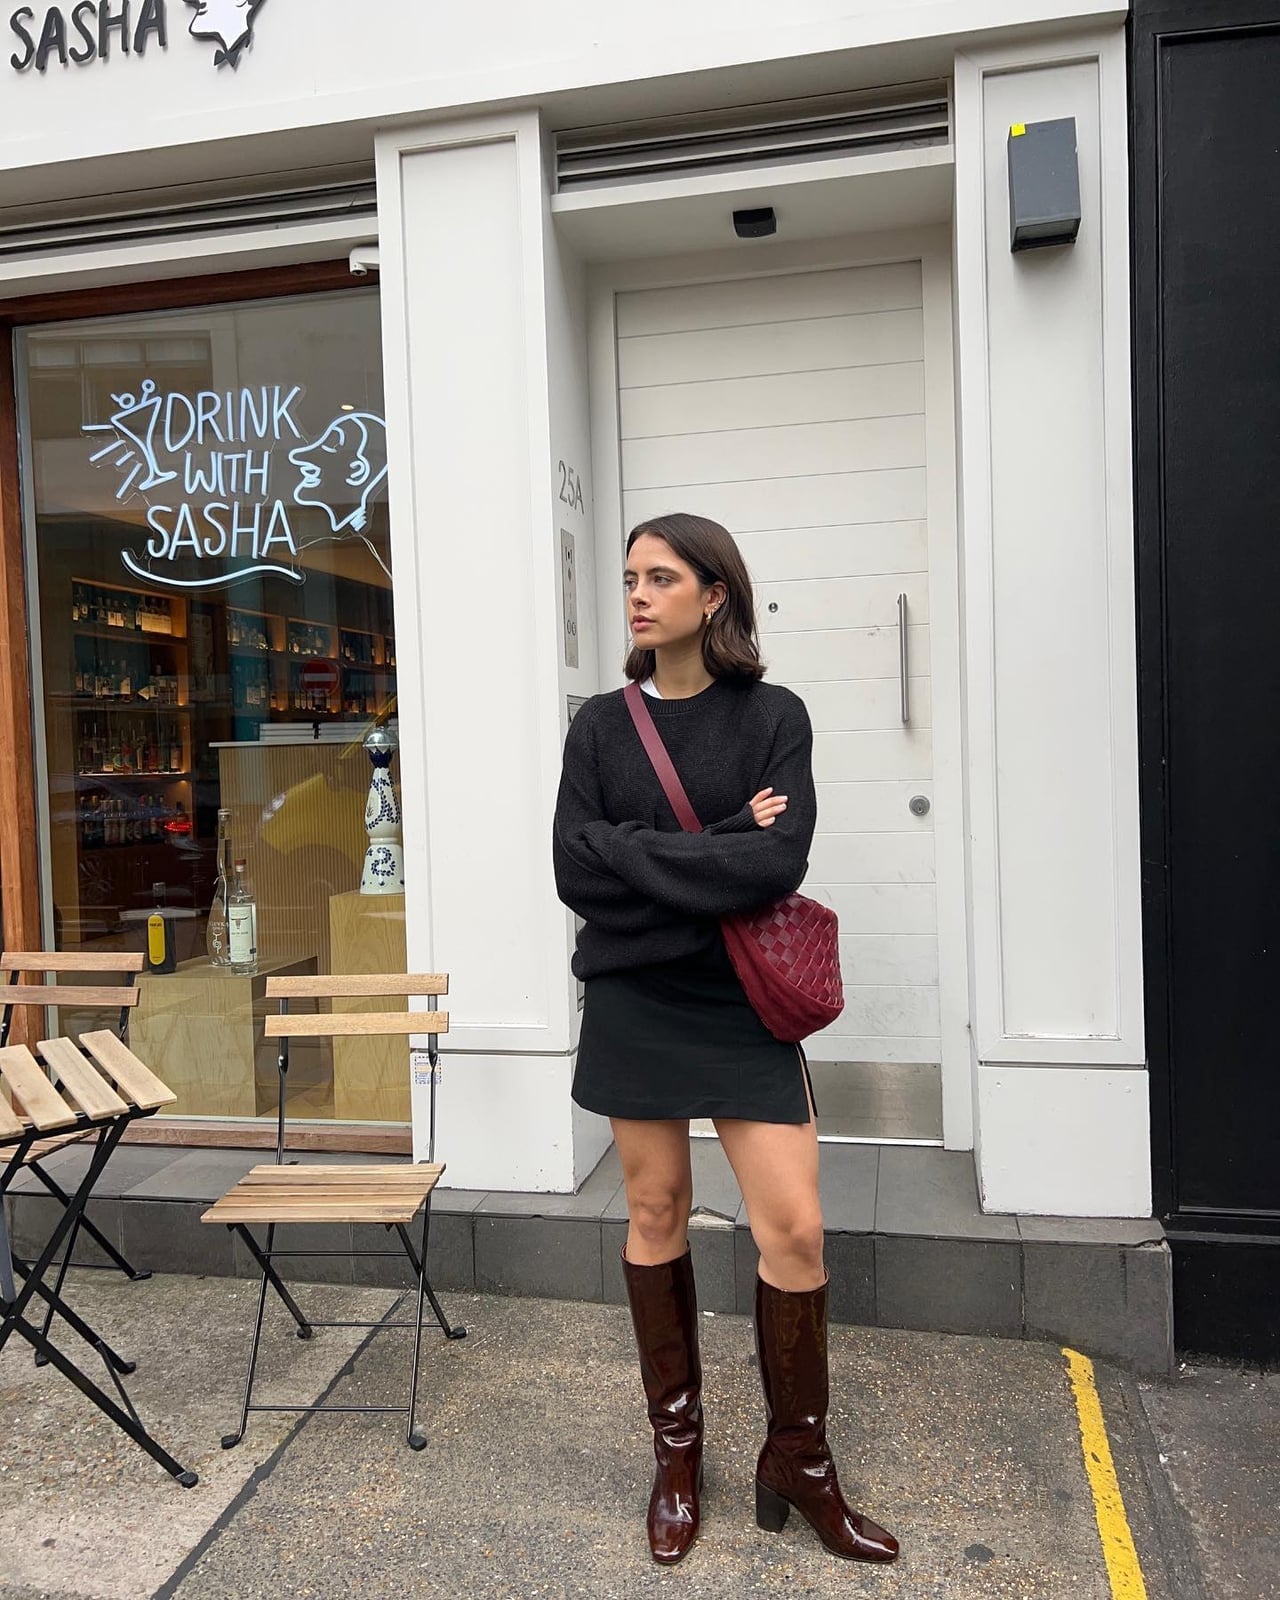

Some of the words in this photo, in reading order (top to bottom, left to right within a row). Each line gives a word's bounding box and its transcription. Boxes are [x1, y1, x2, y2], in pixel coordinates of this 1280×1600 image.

[9, 0, 166, 70] SASHA
[164, 386, 301, 452] DRINK
[185, 450, 270, 497] WITH
[558, 460, 585, 515] 25A
[147, 499, 298, 561] SASHA
